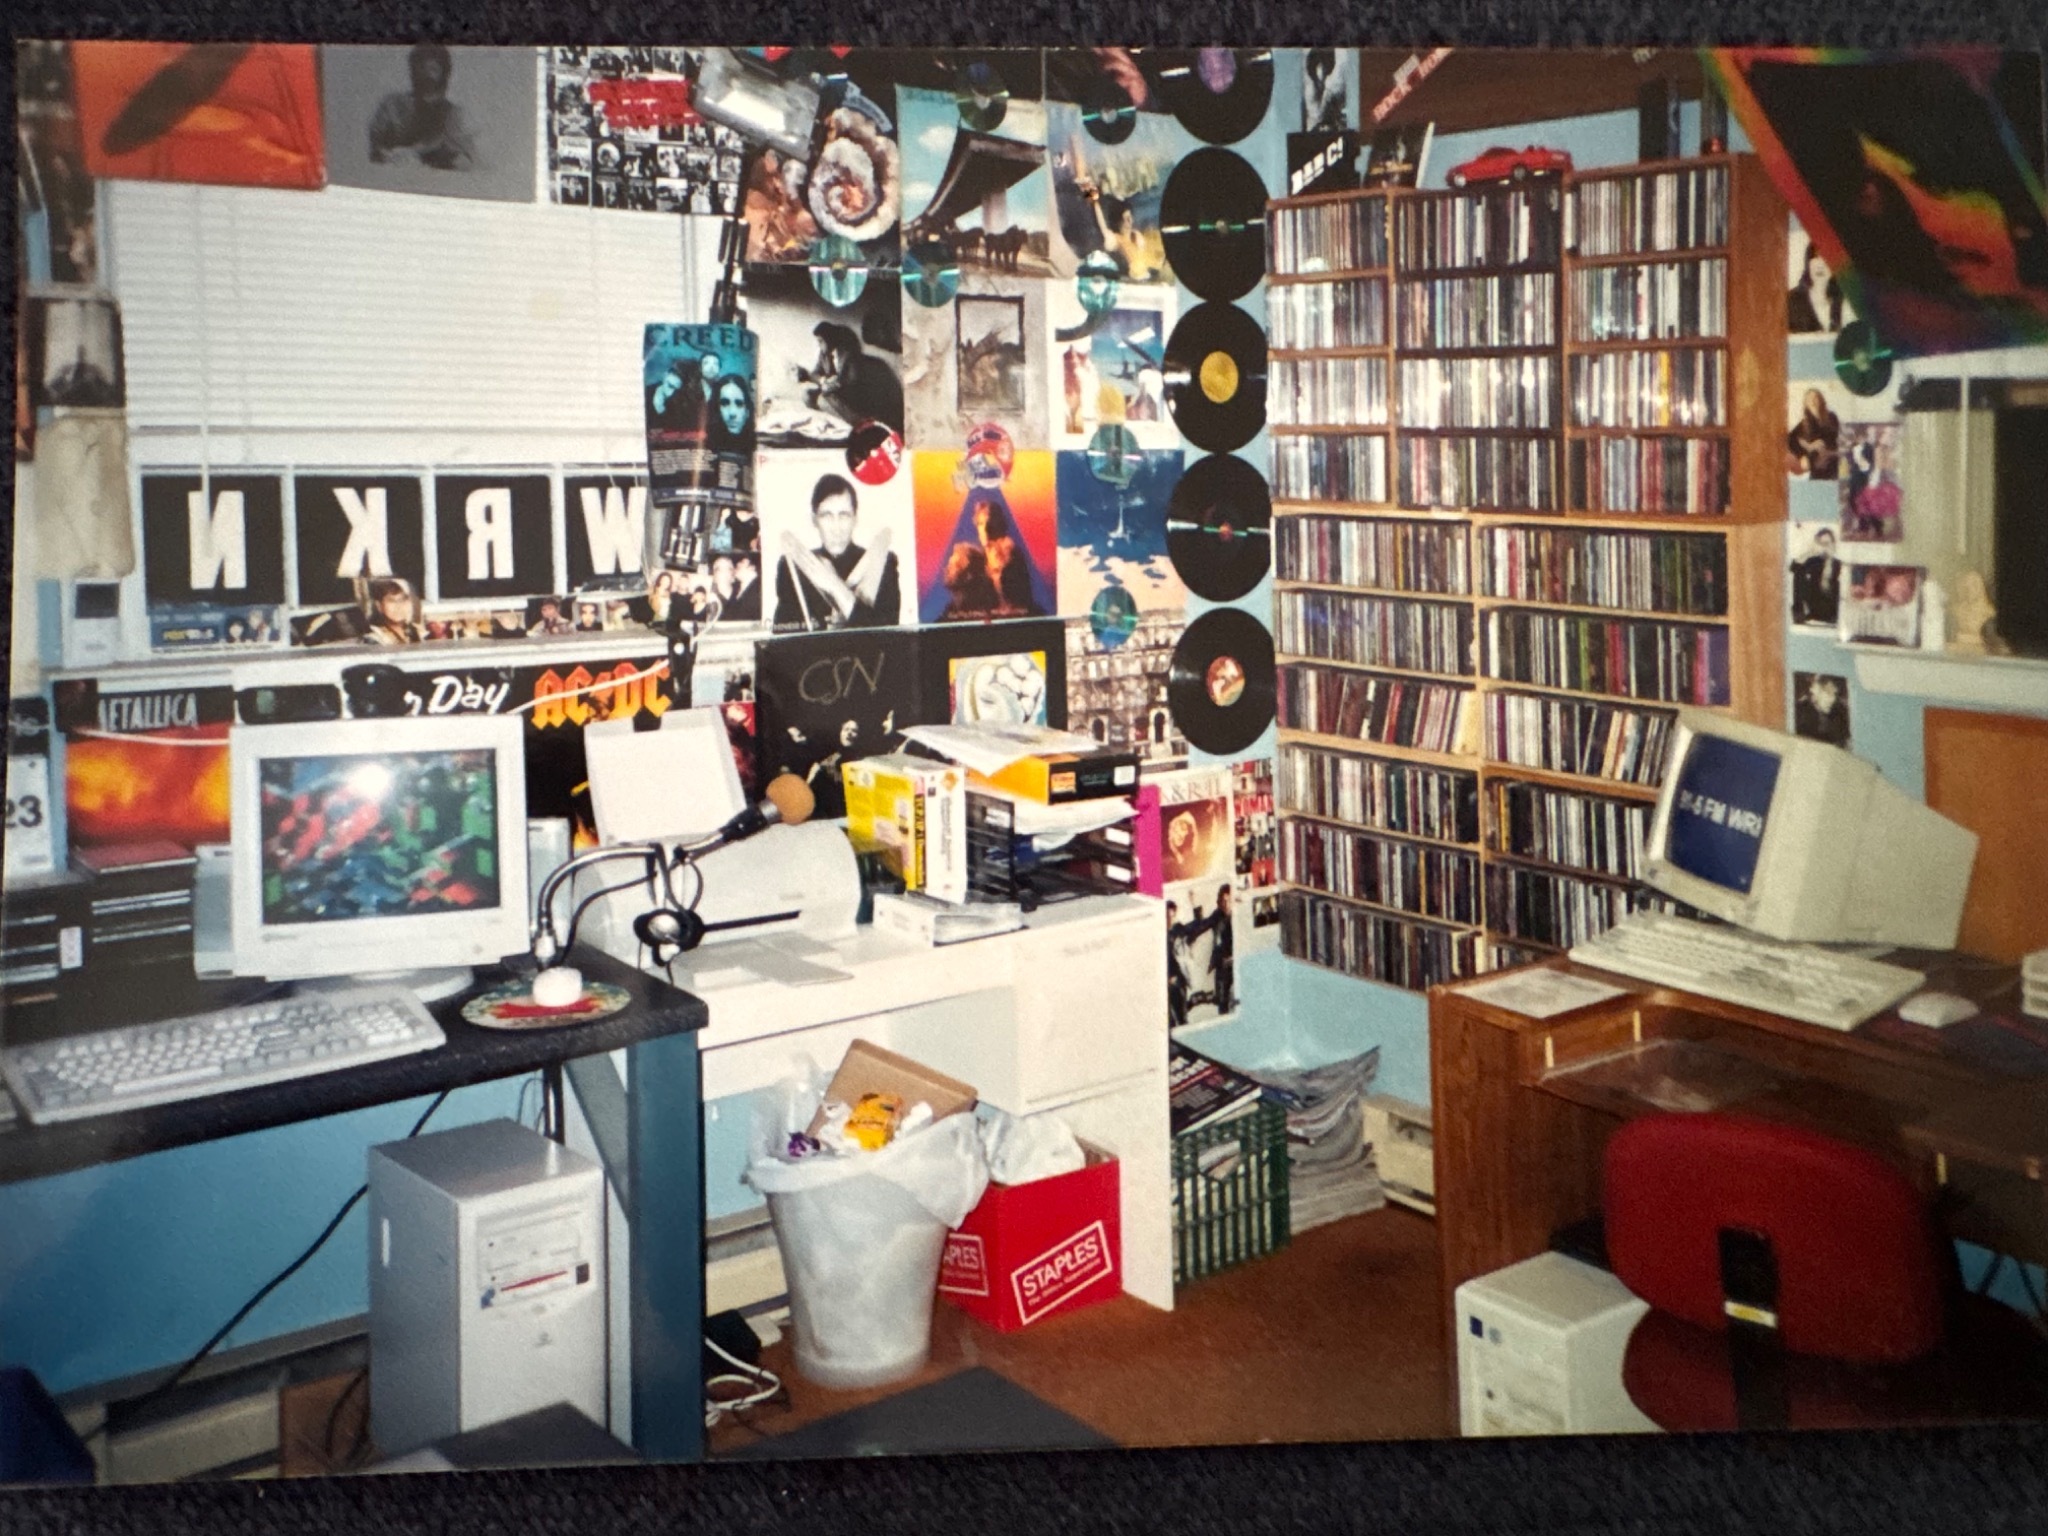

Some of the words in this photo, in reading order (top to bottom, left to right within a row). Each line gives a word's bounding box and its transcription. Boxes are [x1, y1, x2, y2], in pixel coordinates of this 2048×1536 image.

[646, 325, 758, 350] CREED
[427, 674, 511, 716] Day
[799, 651, 886, 705] CSN
[942, 1244, 980, 1270] APLES
[1022, 1234, 1100, 1298] STAPLES
